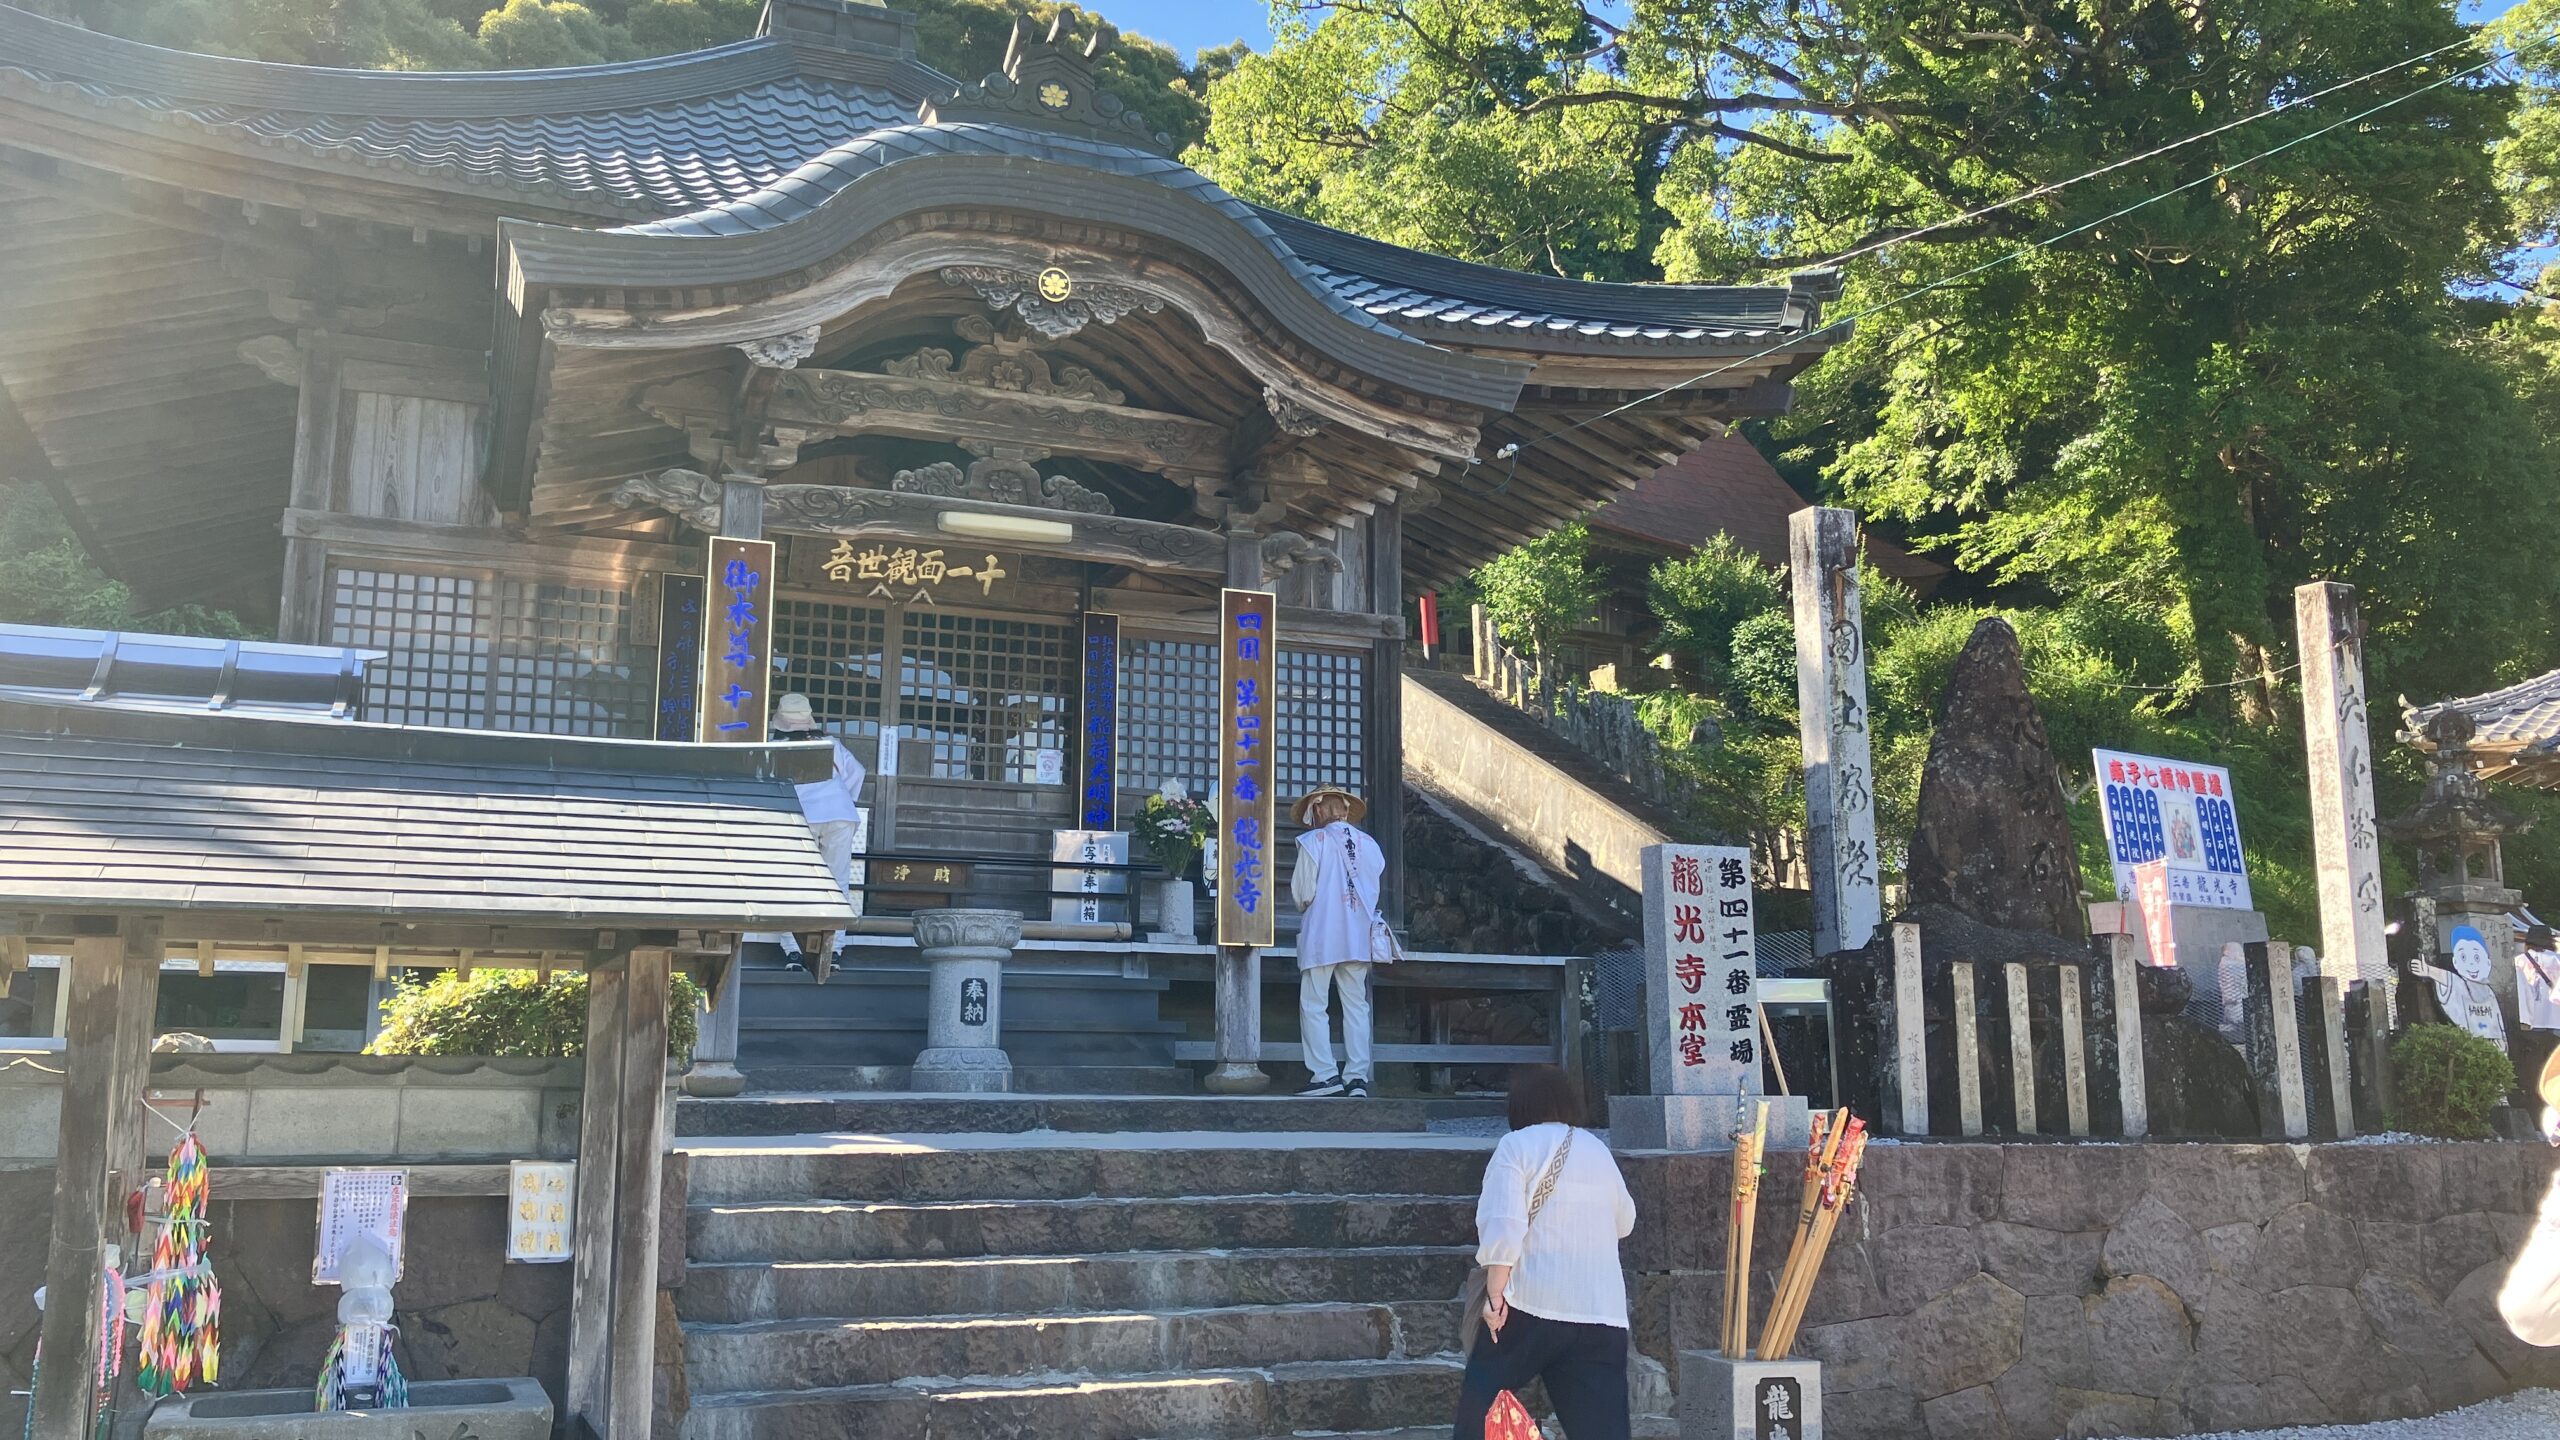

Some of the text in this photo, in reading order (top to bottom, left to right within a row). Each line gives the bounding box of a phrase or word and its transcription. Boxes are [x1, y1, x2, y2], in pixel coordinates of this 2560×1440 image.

[965, 980, 984, 1021] 奉納
[1671, 855, 1706, 1067] 龍光寺本堂
[1718, 857, 1753, 1065] 第四十一番霊場
